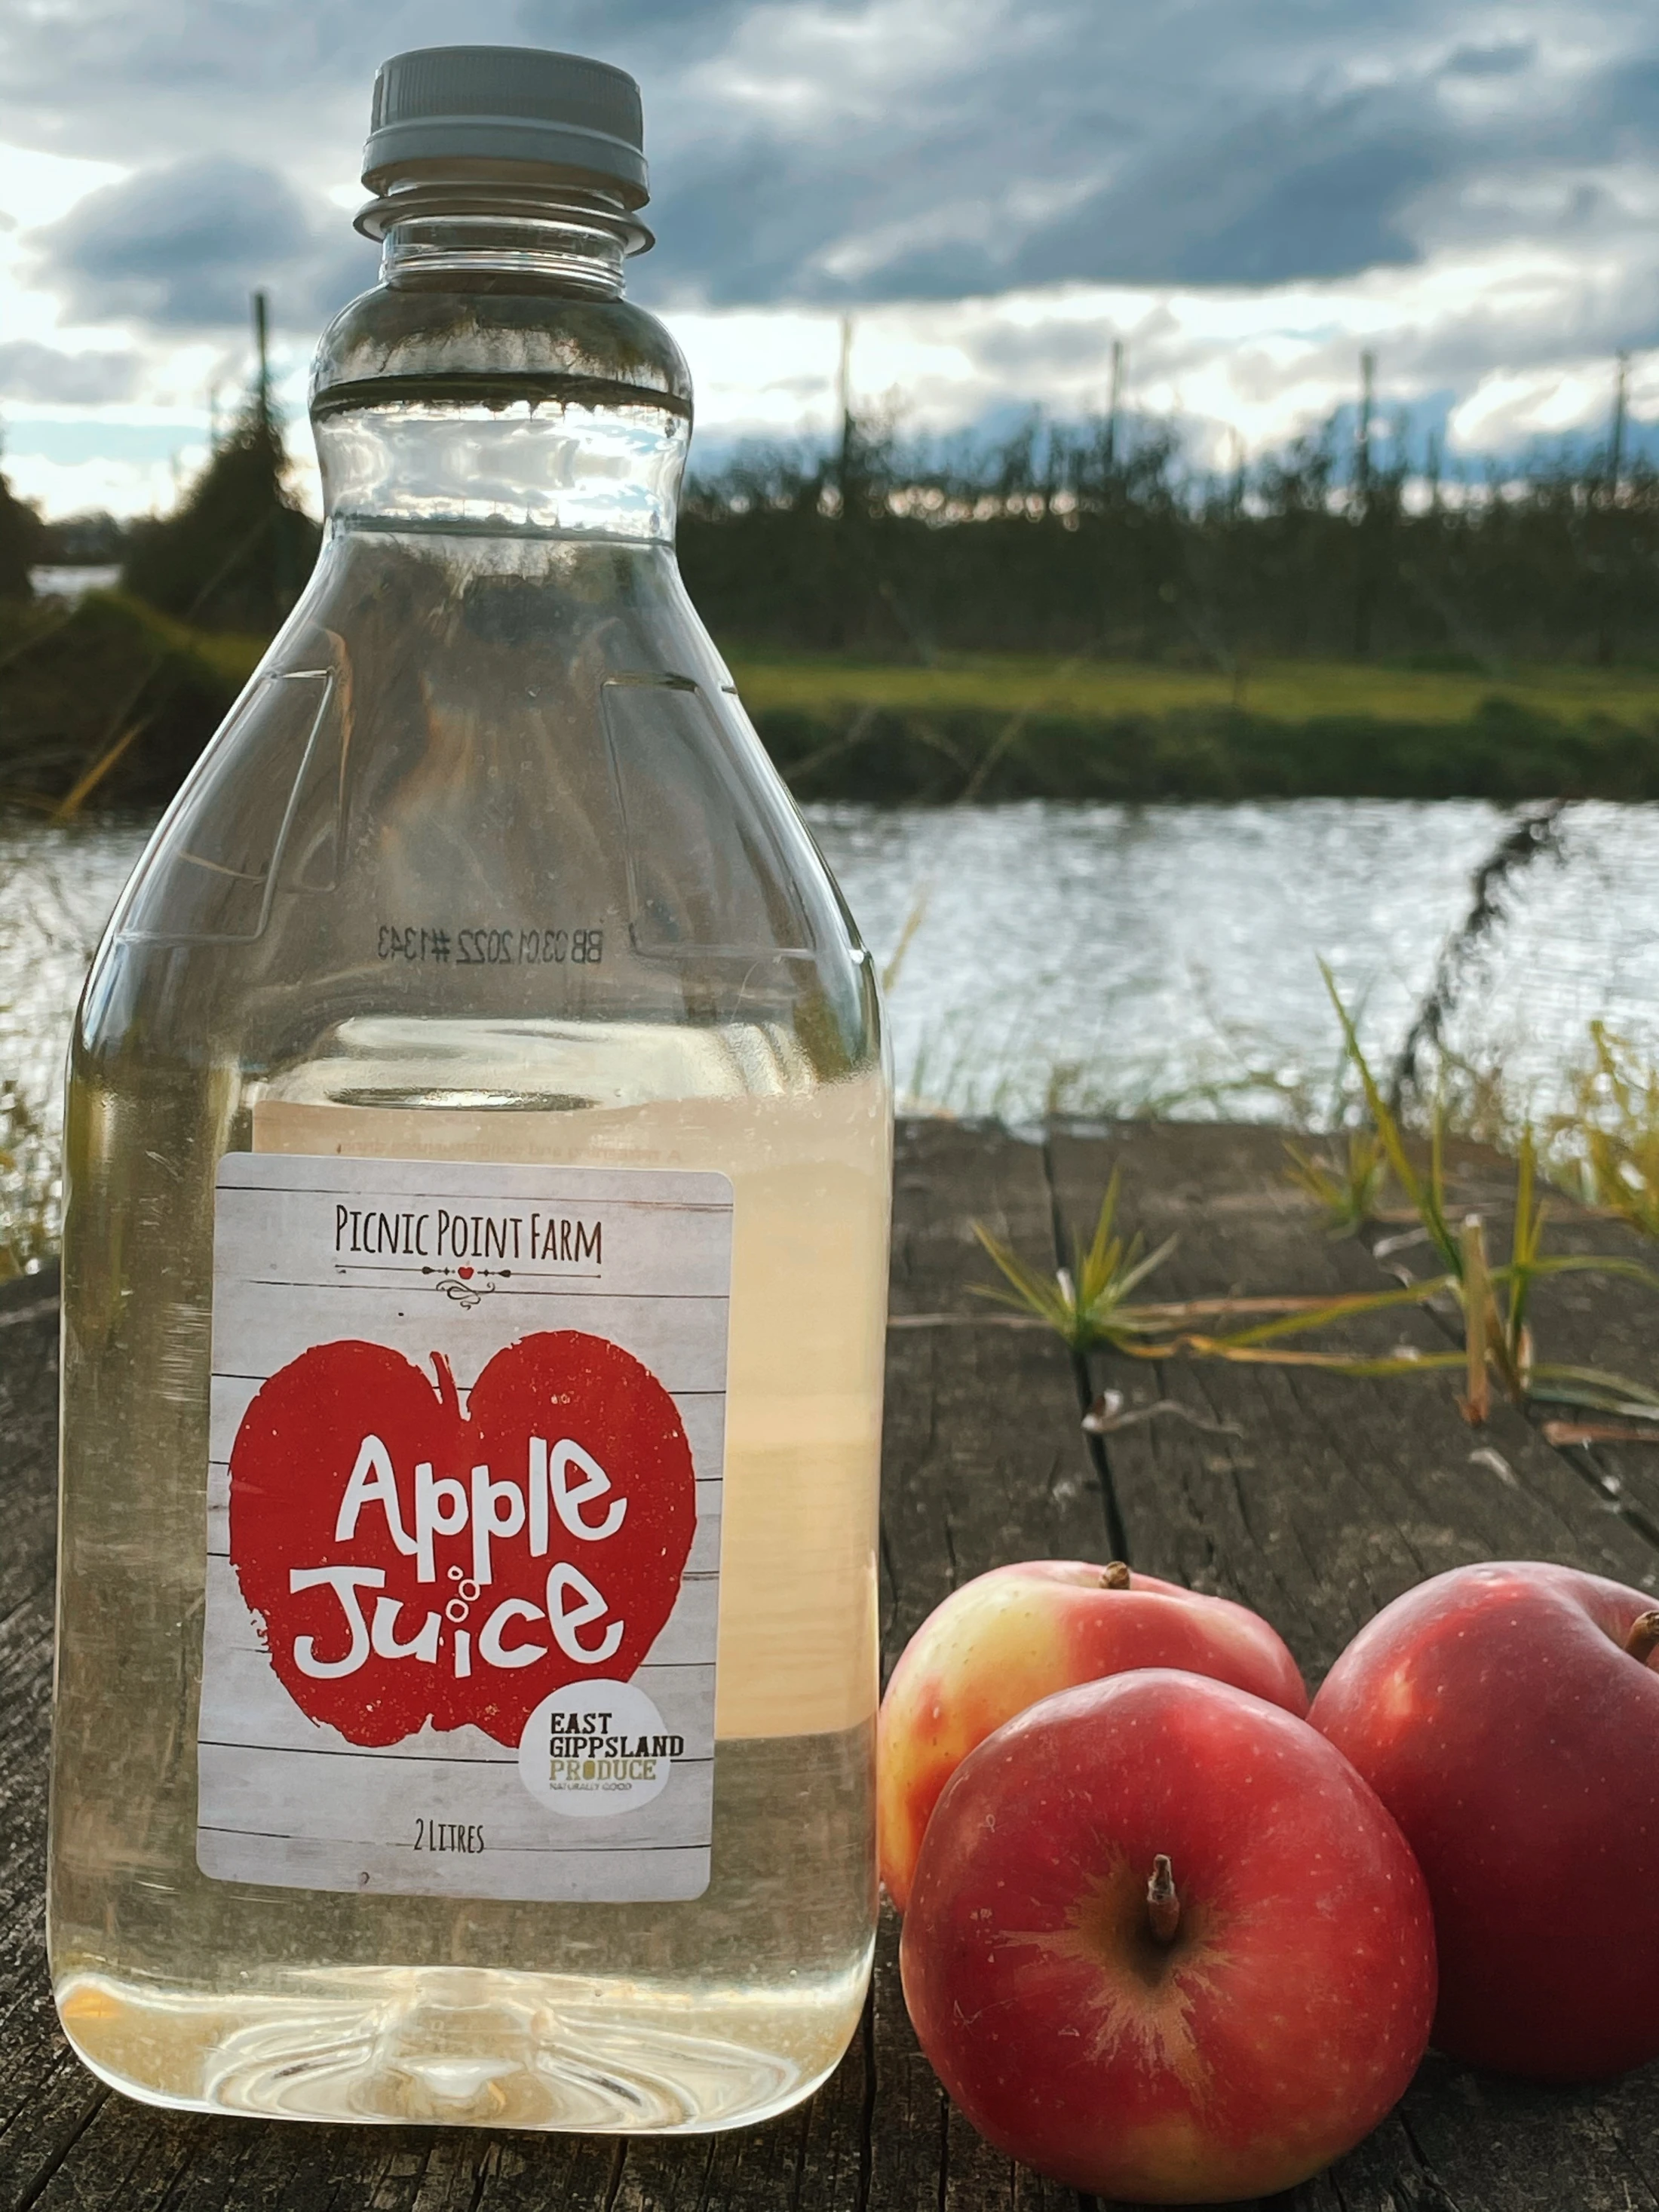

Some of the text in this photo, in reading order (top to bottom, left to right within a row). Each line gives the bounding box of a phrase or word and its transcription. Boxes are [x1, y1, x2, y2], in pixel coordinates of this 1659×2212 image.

[335, 1204, 602, 1264] PICNIC POINT FARM
[335, 1434, 627, 1585] Apple
[290, 1562, 624, 1678] Juice
[550, 1713, 612, 1735] EAST
[549, 1735, 685, 1758] GIPPSLAND
[549, 1759, 657, 1781] PRODUCE
[549, 1782, 633, 1791] NATURALLY GOOD
[413, 1818, 485, 1854] 2 LITRES
